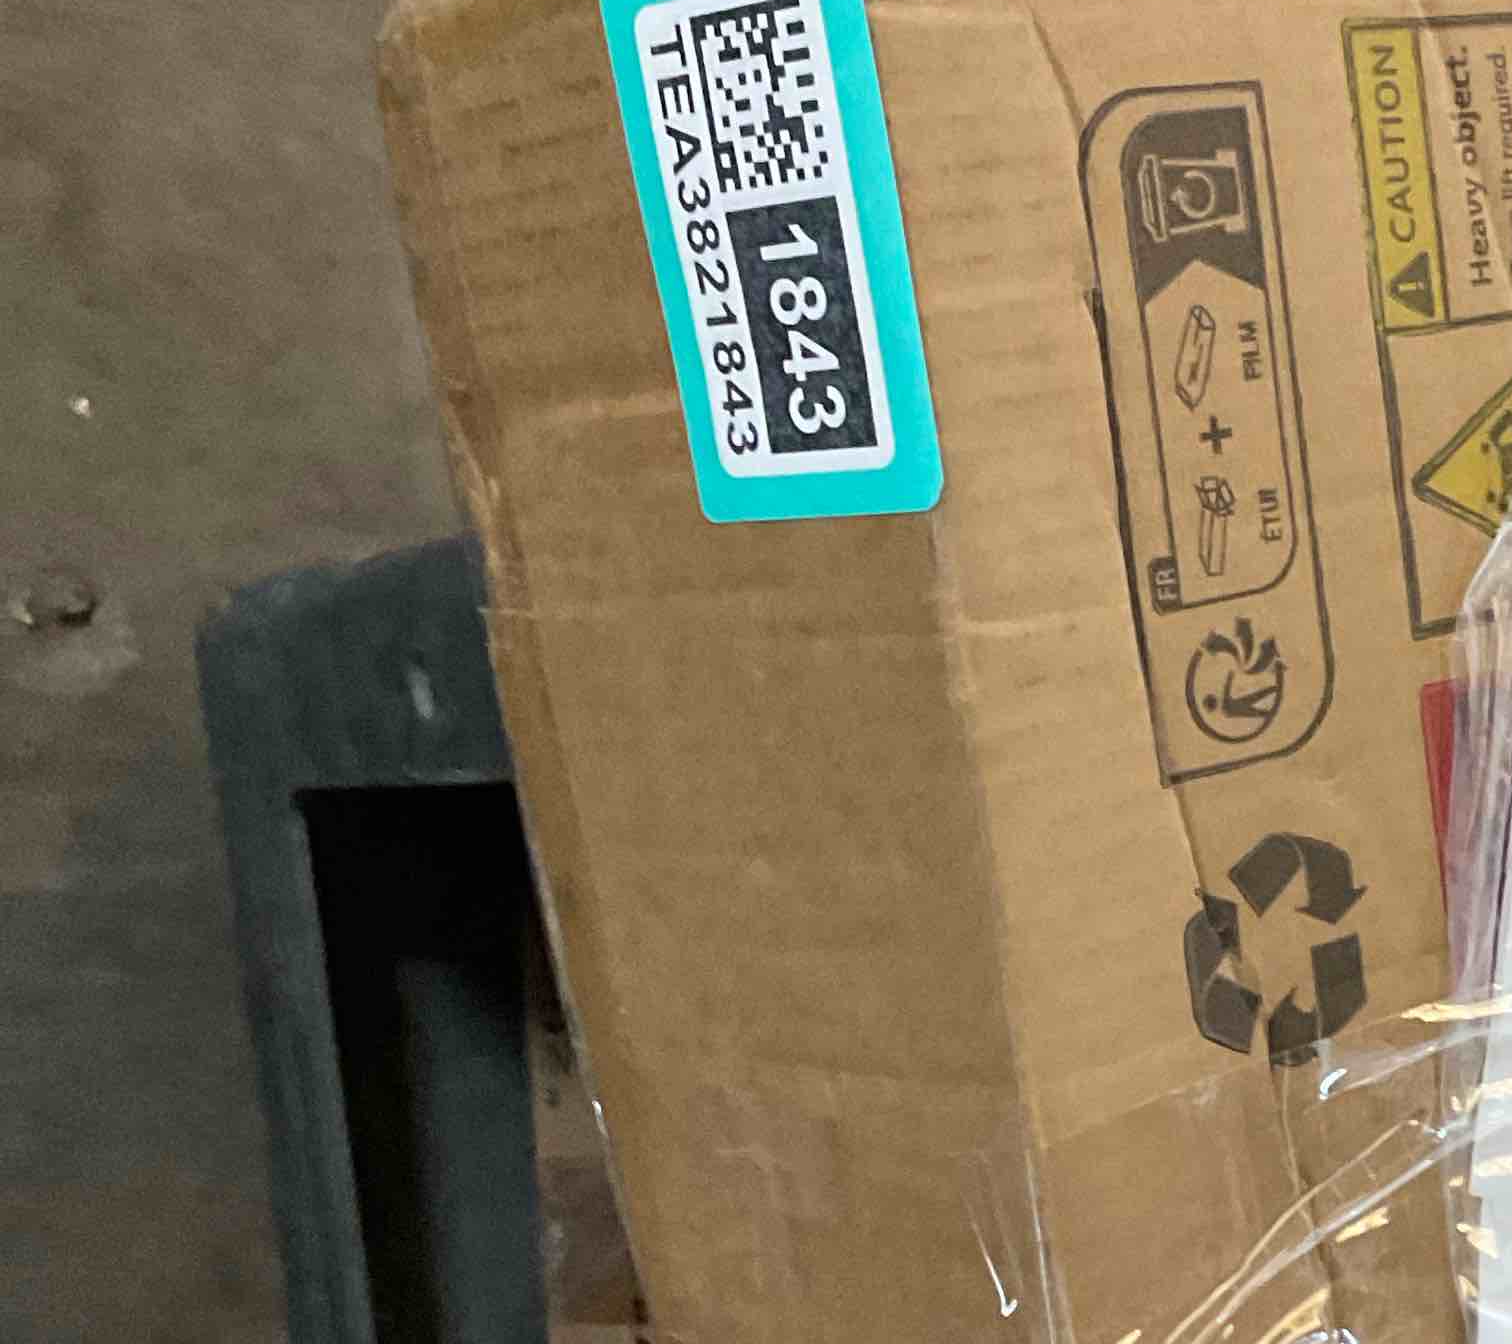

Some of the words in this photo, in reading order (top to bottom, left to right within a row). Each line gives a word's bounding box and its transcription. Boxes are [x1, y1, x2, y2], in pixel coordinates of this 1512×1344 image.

[1368, 44, 1416, 244] CAUTION
[1444, 45, 1481, 168] object.
[648, 24, 760, 457] TEA3821843
[1462, 177, 1495, 288] Heavy
[757, 221, 848, 435] 1843
[1238, 320, 1262, 382] FILM
[1155, 568, 1178, 601] FR
